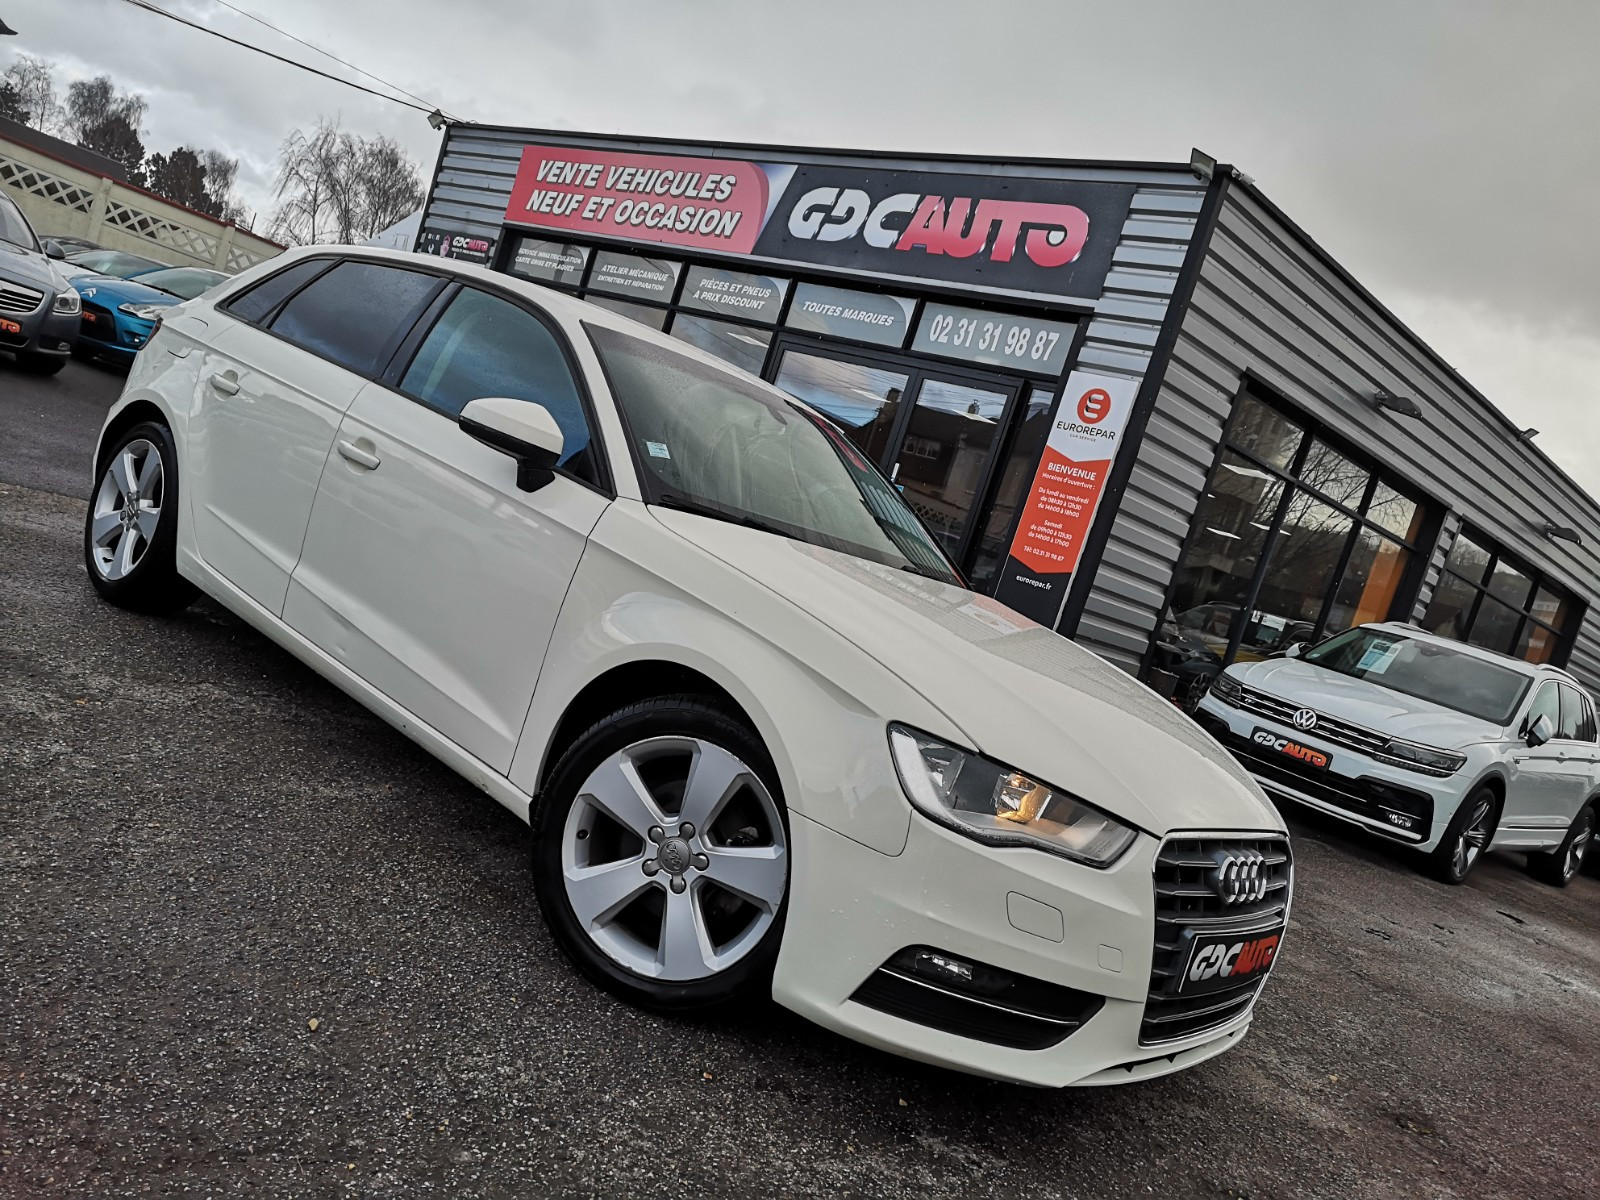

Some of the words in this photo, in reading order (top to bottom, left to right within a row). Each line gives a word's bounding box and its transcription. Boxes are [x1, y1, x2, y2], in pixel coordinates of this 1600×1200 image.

[536, 159, 604, 187] VENTE
[605, 165, 737, 201] VEHICULES
[525, 188, 584, 216] NEUF
[581, 195, 616, 221] ET
[614, 198, 742, 238] OCCASION
[518, 248, 539, 256] SERVICE
[530, 258, 545, 267] GRISE
[552, 264, 575, 272] PLAQUES
[601, 264, 629, 276] ATELIER
[628, 267, 670, 282] MÉCANIQUE
[597, 274, 624, 286] ENTRETIEN
[700, 278, 730, 291] PIÈCES
[728, 283, 742, 293] ET
[740, 285, 772, 298] PNEUS
[700, 291, 722, 302] PRIX
[720, 294, 766, 310] DISCOUNT
[802, 301, 843, 317] TOUTES
[841, 308, 895, 327] MARQUES
[929, 313, 954, 344] 02
[953, 318, 978, 347] 31
[978, 322, 1003, 352] 31
[1004, 326, 1031, 357] 98
[1031, 330, 1060, 361] 87
[1056, 420, 1116, 440] EUROREPAR
[1047, 462, 1097, 481] BIENVENUE
[1042, 472, 1063, 482] Horaires
[1062, 477, 1093, 490] d'ouverture
[1046, 488, 1060, 497] lundi
[1066, 494, 1090, 504] vendredi
[1044, 504, 1060, 513] 14h00
[1064, 509, 1080, 518] 18h00
[1067, 502, 1082, 511] 12h30
[1044, 520, 1063, 530] Samedi
[1034, 532, 1050, 542] 14h00
[1054, 538, 1070, 548] 17h00
[1016, 575, 1052, 591] eurorepar.fr
